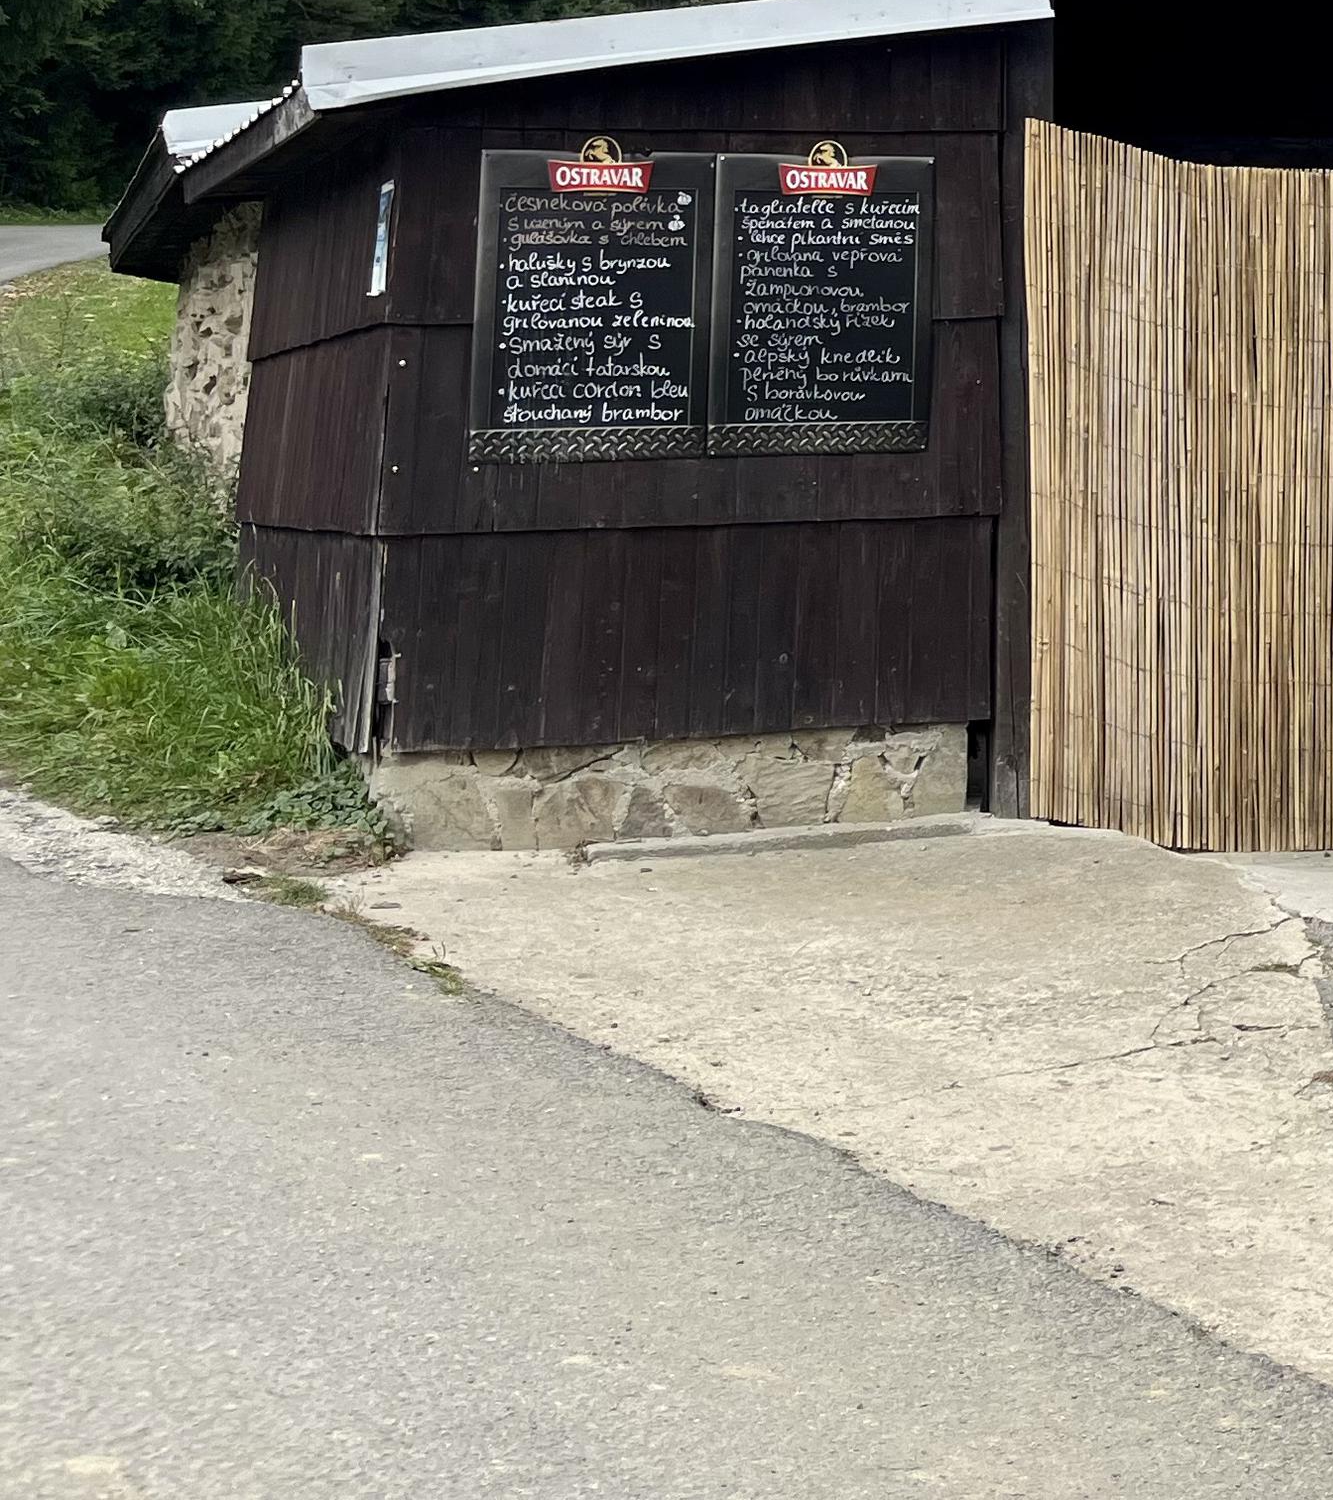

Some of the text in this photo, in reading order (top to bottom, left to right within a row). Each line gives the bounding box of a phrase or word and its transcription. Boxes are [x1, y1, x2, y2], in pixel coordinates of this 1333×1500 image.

[556, 166, 644, 188] OSTRAVAR
[786, 169, 868, 191] OSTRAVAR
[740, 196, 835, 219] tagliatelle
[591, 221, 605, 230] a
[821, 219, 833, 229] a
[841, 215, 916, 230] smetanou
[508, 252, 576, 276] halušky
[600, 249, 671, 274] brynzou
[506, 271, 616, 290] a slaninou
[506, 292, 566, 313] kuřecí
[570, 289, 623, 310] steak
[840, 296, 911, 314] brambor
[502, 309, 696, 336] grilovanou zeleninou
[744, 313, 841, 336] holandský
[603, 332, 632, 356] sýr
[736, 333, 759, 347] se
[585, 352, 671, 377] tatarskou
[744, 346, 810, 370] alpský
[573, 381, 642, 398] cordon
[651, 379, 688, 399] bleu
[601, 402, 684, 424] brambor
